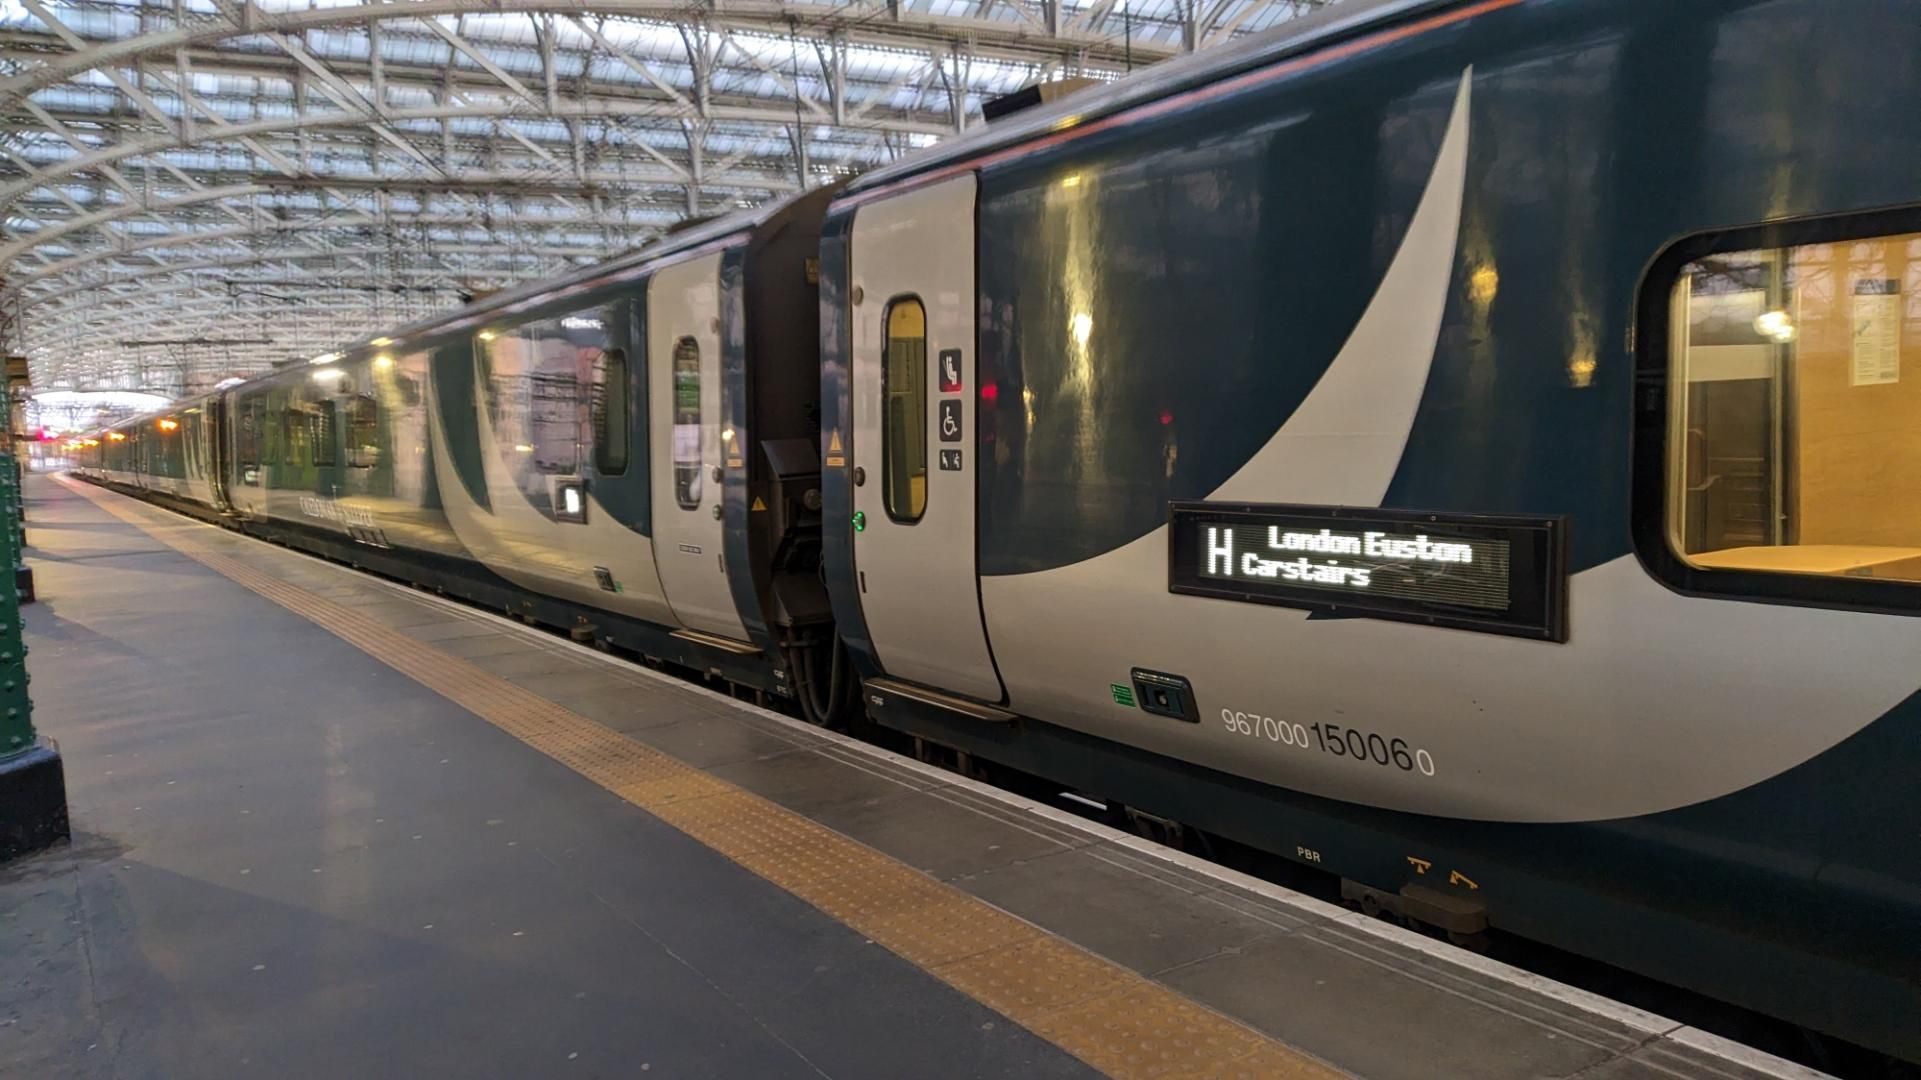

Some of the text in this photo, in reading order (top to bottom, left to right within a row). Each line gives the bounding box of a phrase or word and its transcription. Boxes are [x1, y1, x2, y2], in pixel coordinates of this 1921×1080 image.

[1207, 527, 1233, 576] H
[1267, 525, 1473, 564] London Euston
[1240, 552, 1371, 587] Carstairs
[1296, 846, 1322, 863] PBR
